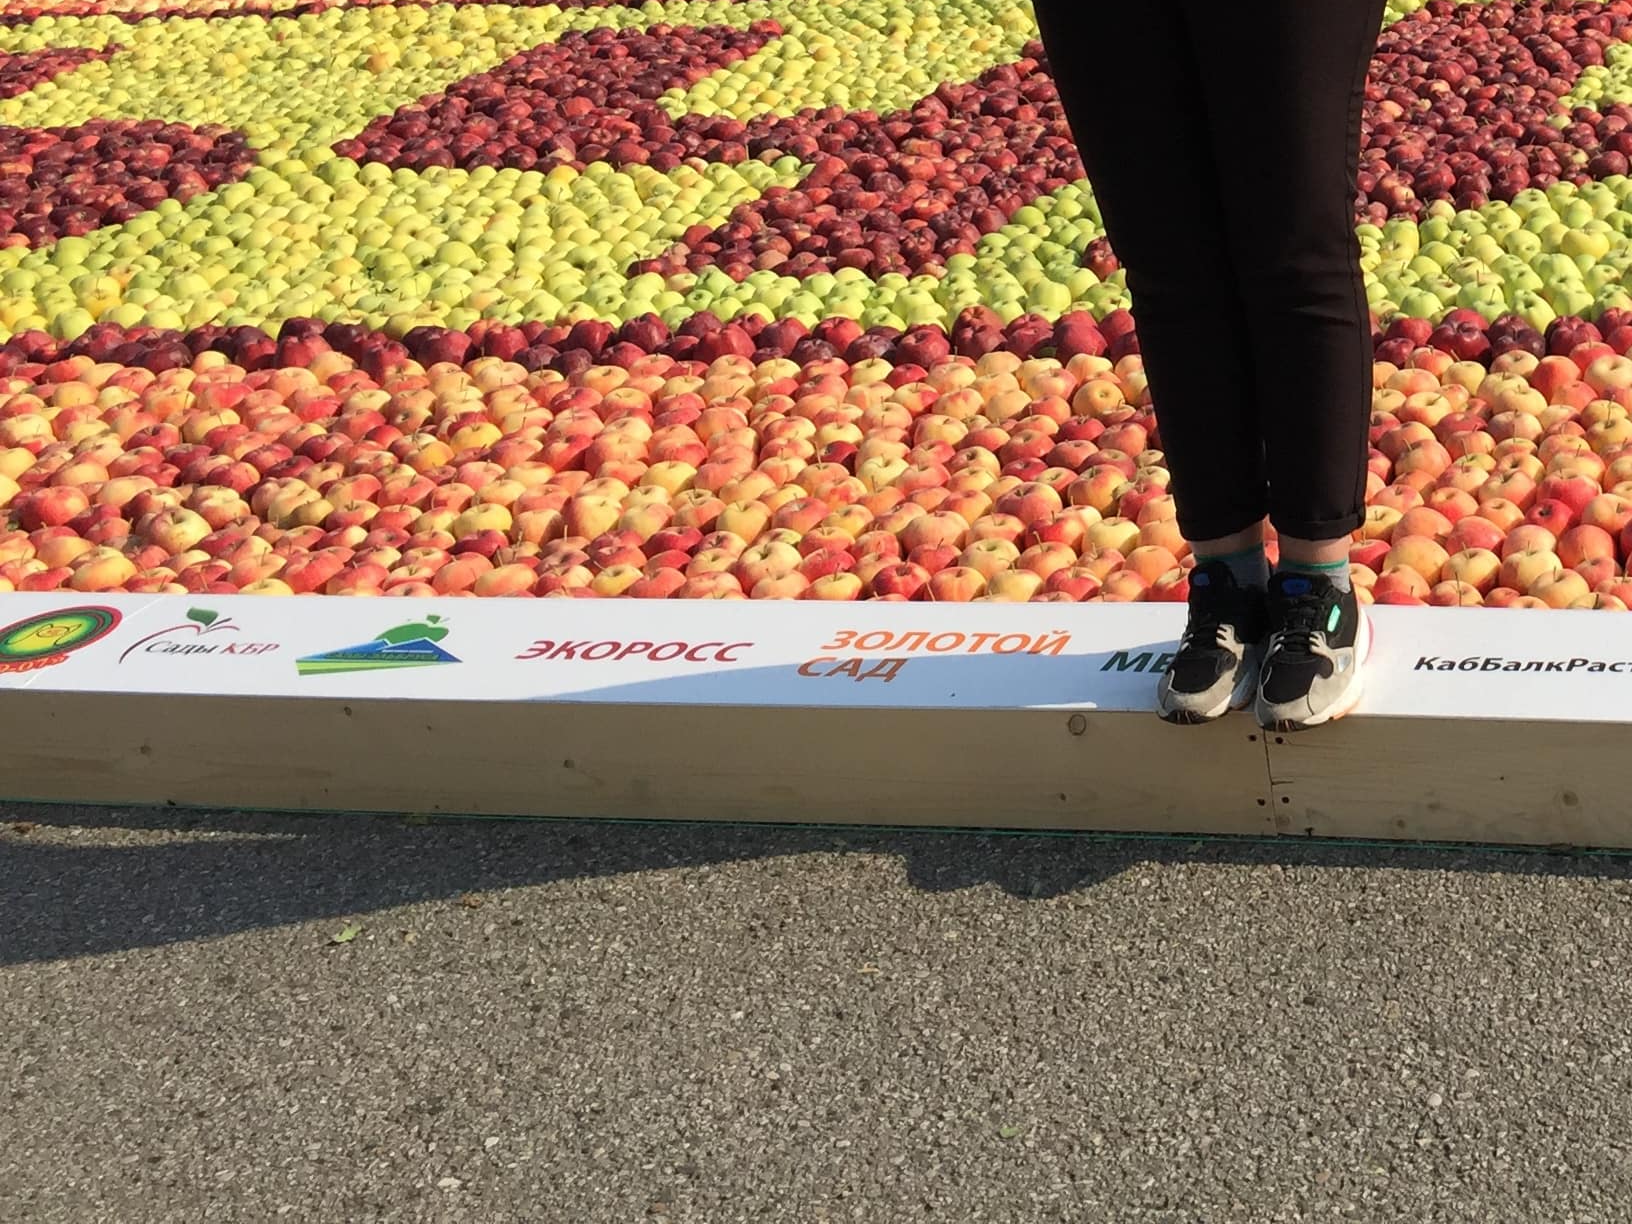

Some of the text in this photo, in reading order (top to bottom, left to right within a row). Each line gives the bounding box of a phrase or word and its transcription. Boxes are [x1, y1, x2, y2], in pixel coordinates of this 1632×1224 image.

[145, 640, 280, 655] Сады КБР
[515, 640, 754, 662] ЭКОРОСС
[820, 629, 1072, 656] ЗОЛОТОЙ
[797, 657, 910, 683] САД
